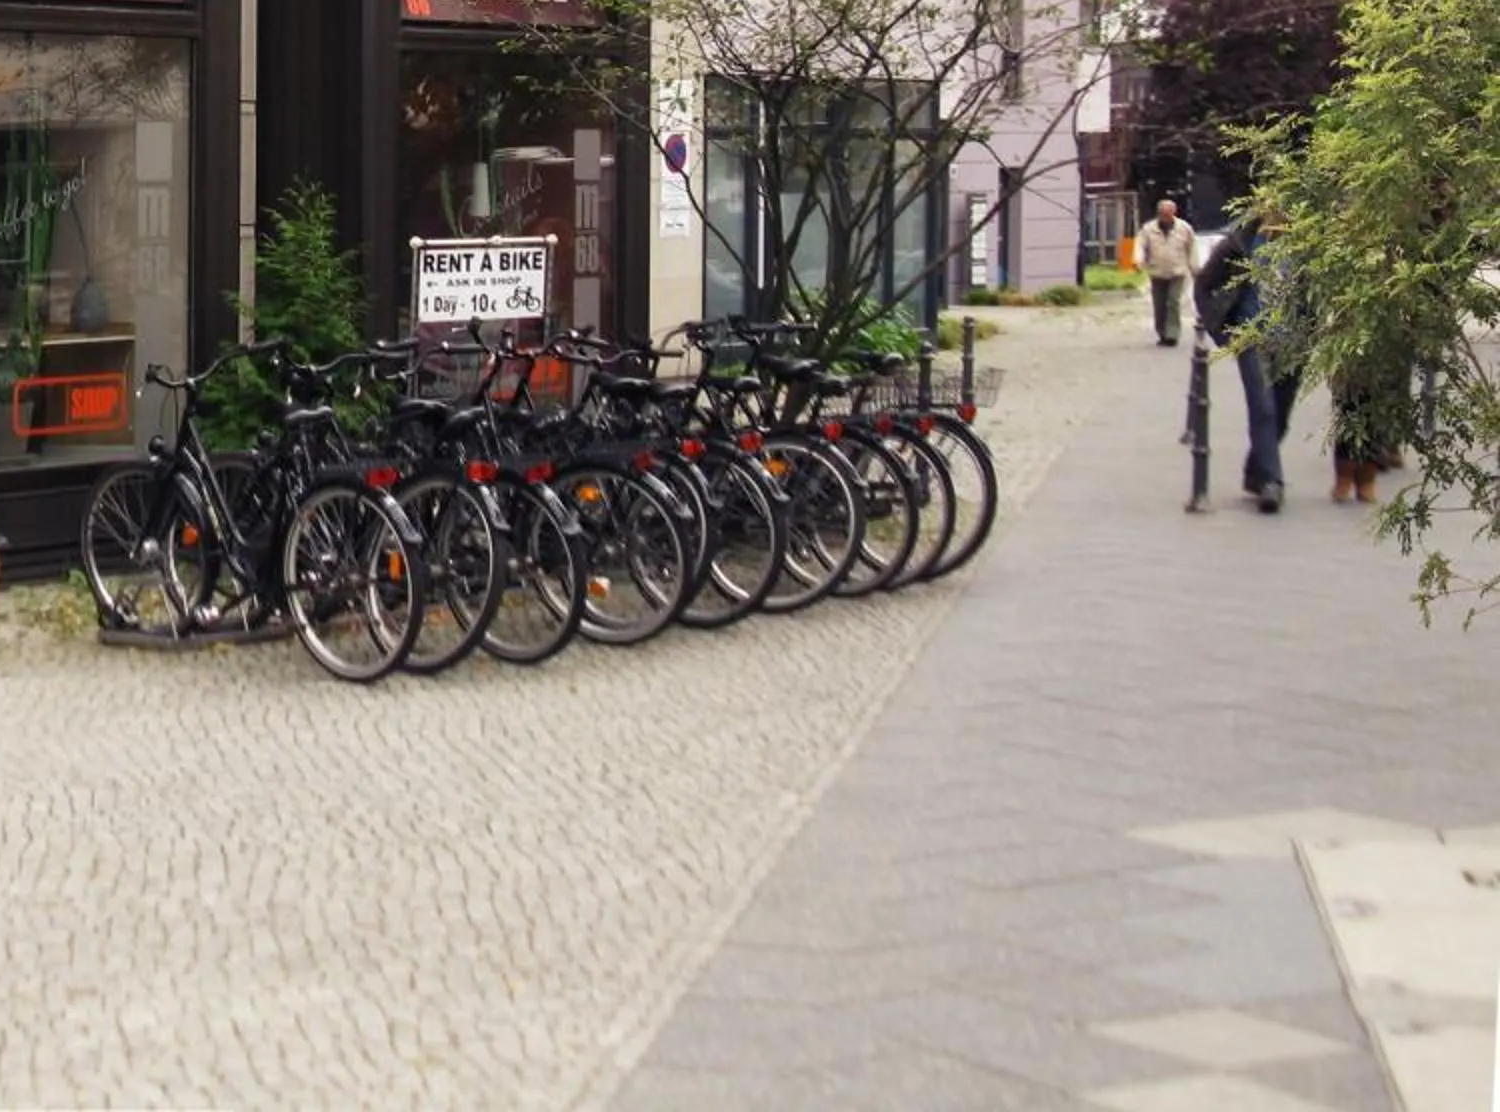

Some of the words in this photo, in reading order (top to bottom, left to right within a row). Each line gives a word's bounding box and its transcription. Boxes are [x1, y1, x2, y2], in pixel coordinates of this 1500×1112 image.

[423, 252, 475, 274] RENT
[480, 253, 493, 272] A
[500, 252, 543, 272] BIKE
[446, 277, 471, 288] ASK
[490, 276, 522, 286] SHOP
[423, 296, 429, 313] 1
[433, 296, 457, 317] Day
